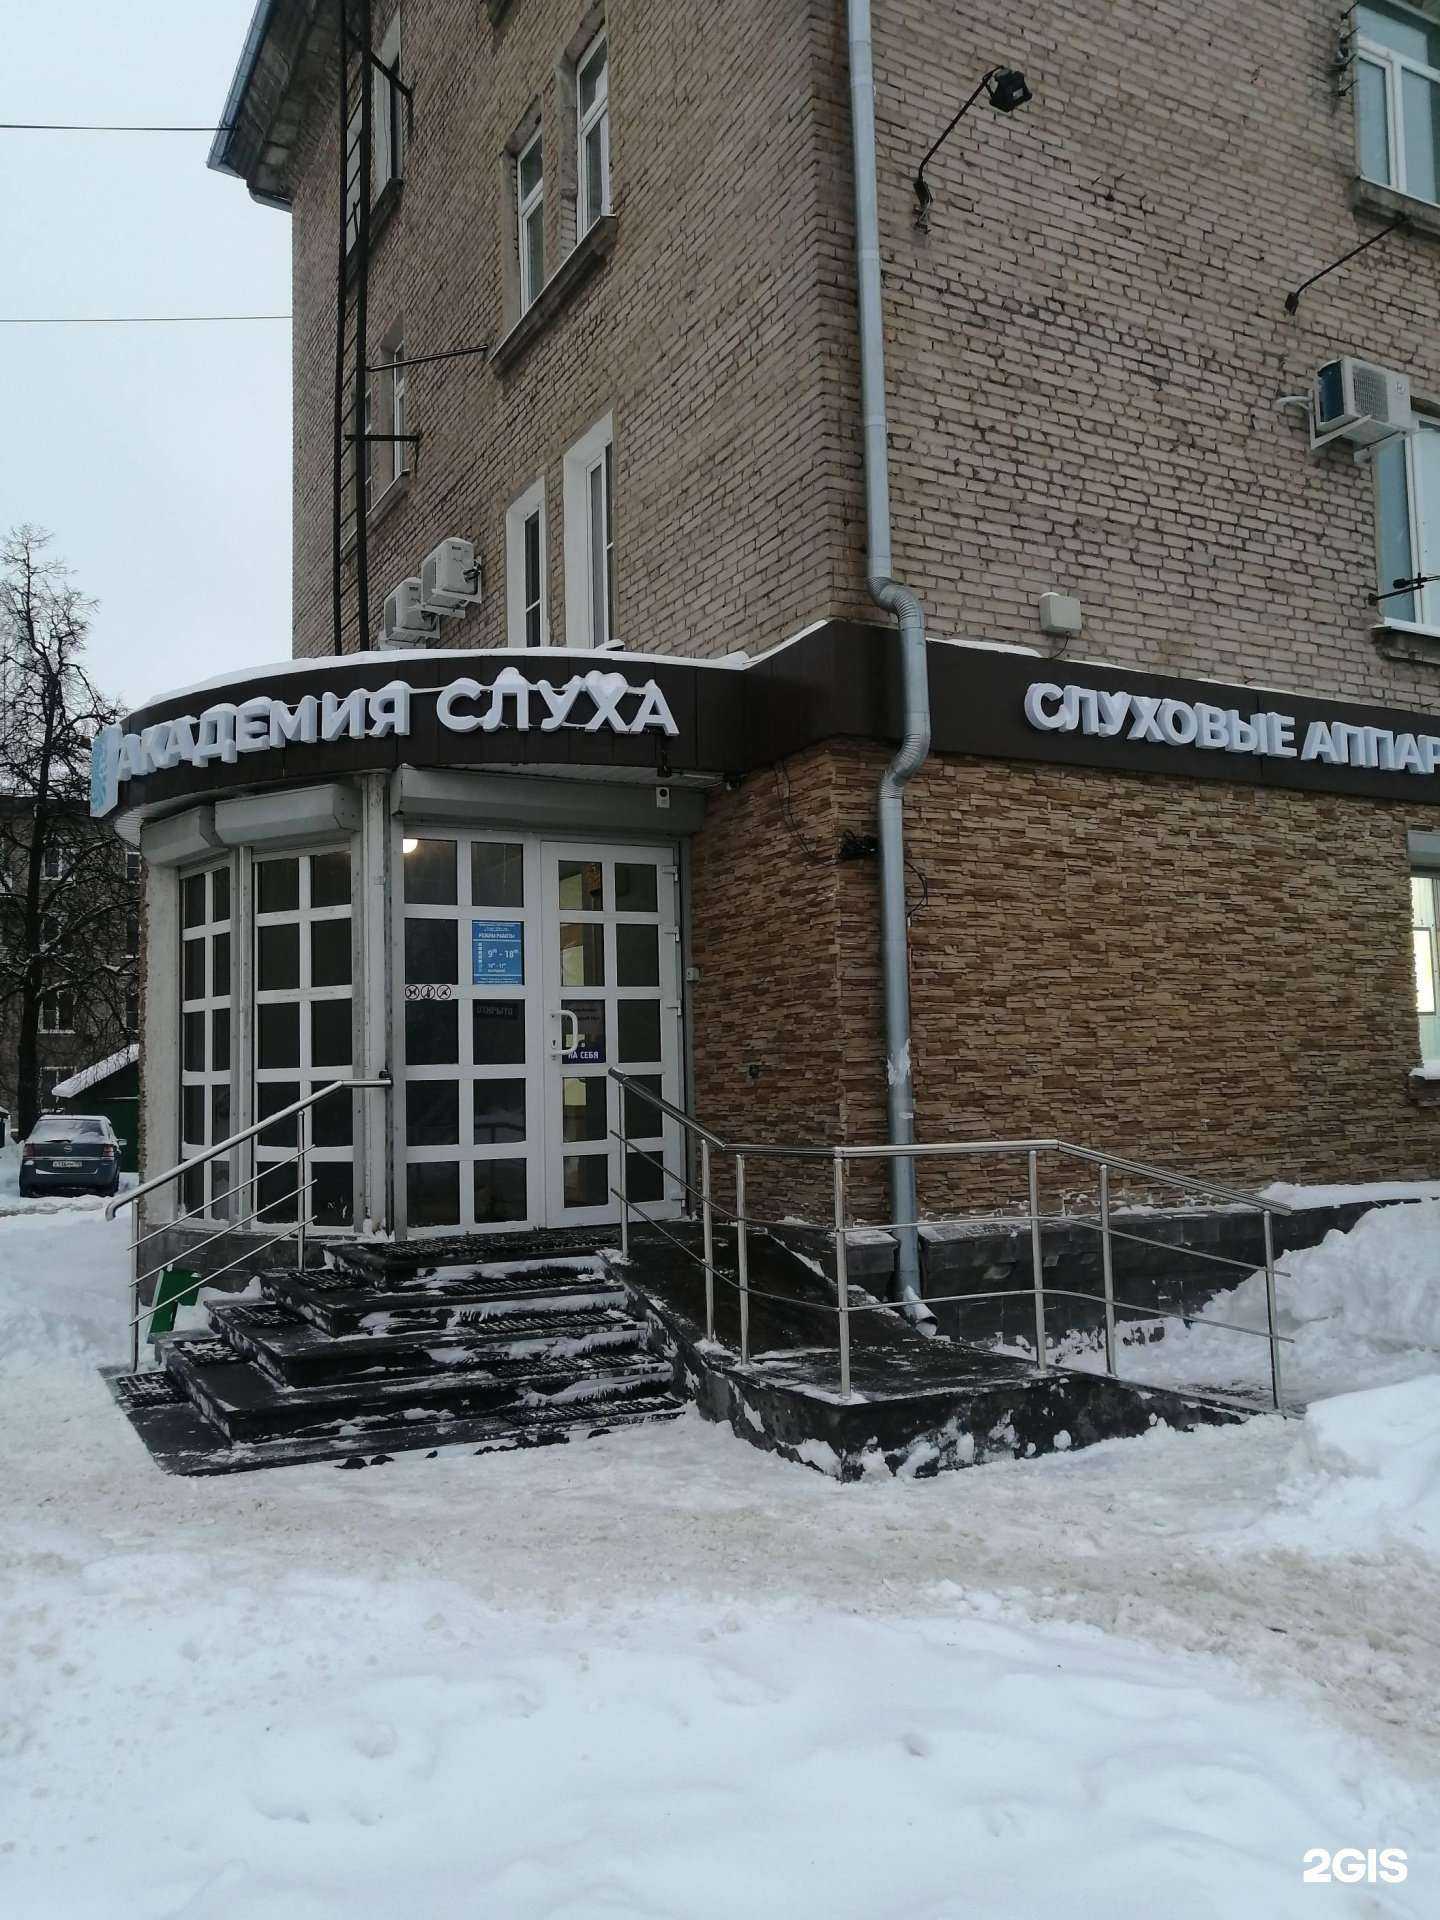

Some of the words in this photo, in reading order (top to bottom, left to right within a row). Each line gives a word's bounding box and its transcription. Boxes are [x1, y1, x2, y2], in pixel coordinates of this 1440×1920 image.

[117, 681, 410, 781] АКАДЕМИЯ
[436, 668, 680, 737] СЛУХА
[1024, 682, 1298, 758] СЛУХОВЫЕ
[580, 1051, 599, 1060] СЕБЯ
